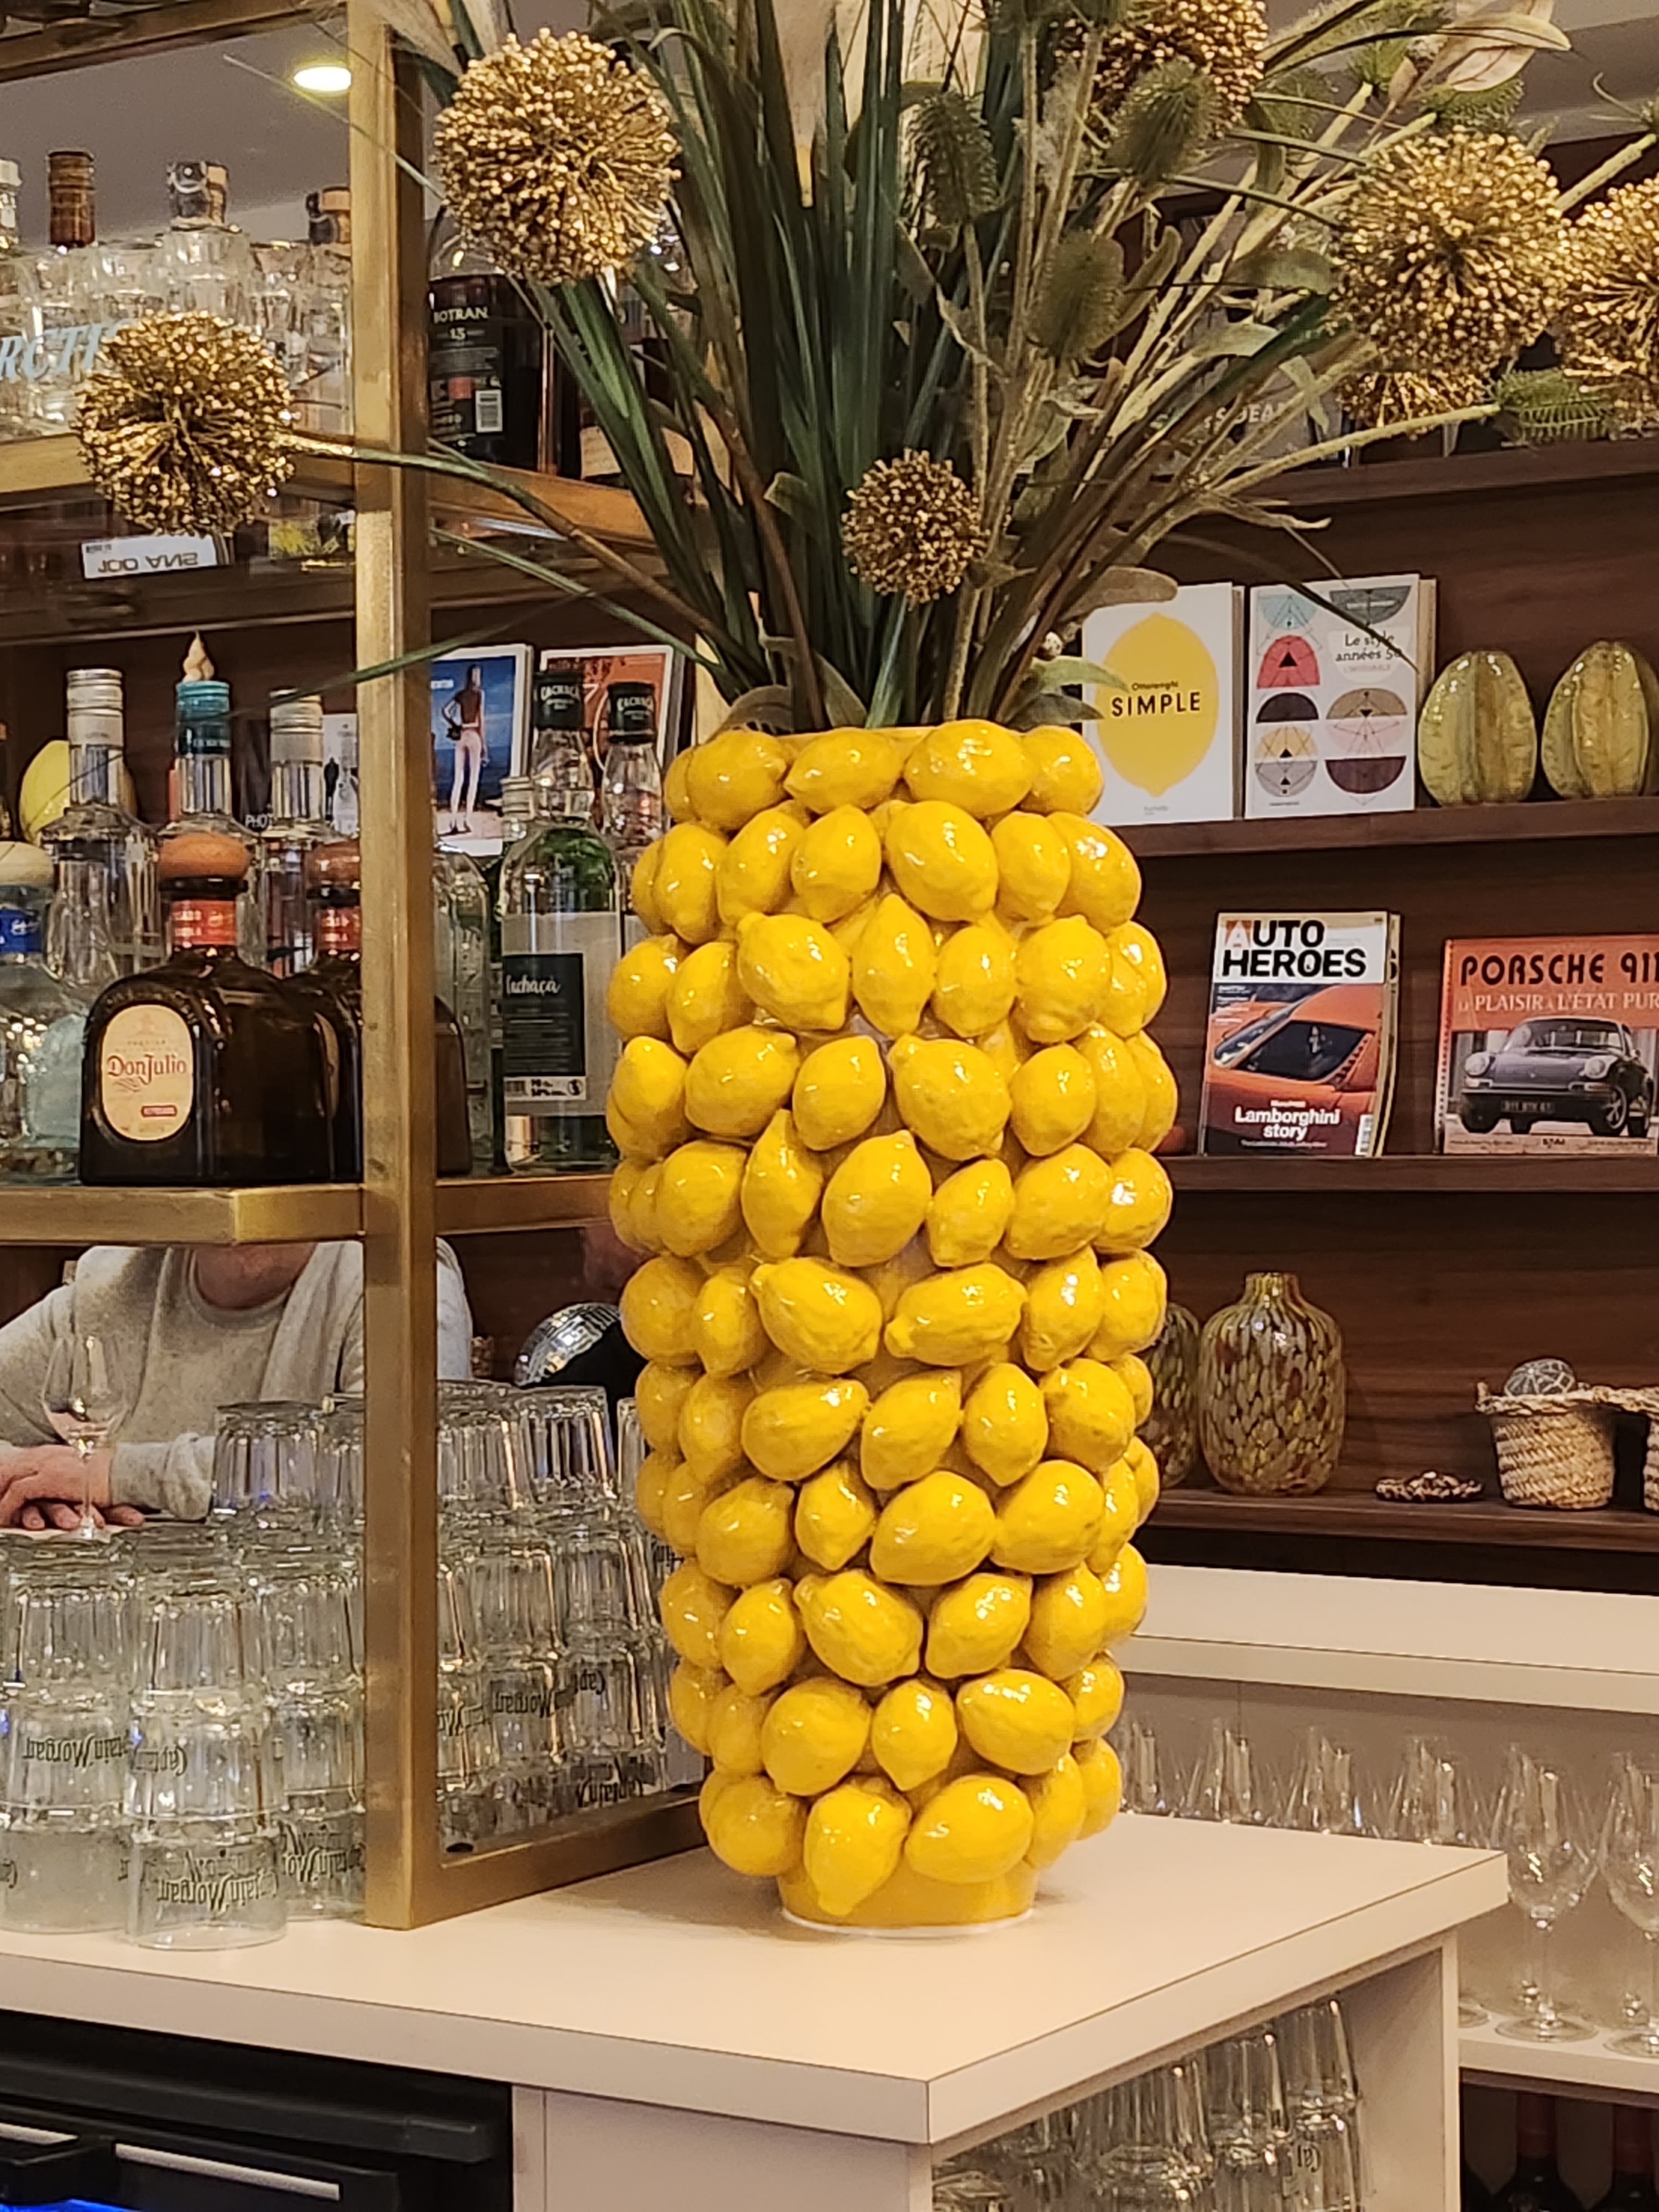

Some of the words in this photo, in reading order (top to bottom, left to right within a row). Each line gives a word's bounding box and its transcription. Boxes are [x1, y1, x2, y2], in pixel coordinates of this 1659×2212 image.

[1345, 633, 1360, 646] Le
[1336, 648, 1381, 661] années
[1112, 692, 1200, 717] SIMPLE
[244, 814, 272, 828] PHO
[1224, 920, 1325, 947] AUTO
[1222, 948, 1366, 977] HEROES
[1460, 954, 1604, 986] PORSCHE
[1475, 994, 1543, 1011] PLAISIR
[1623, 993, 1659, 1010] PUR
[1234, 1106, 1341, 1126] Lamborghini
[1263, 1124, 1307, 1141] story
[23, 1733, 95, 1768] Morgan
[157, 1872, 235, 1912] Morgan
